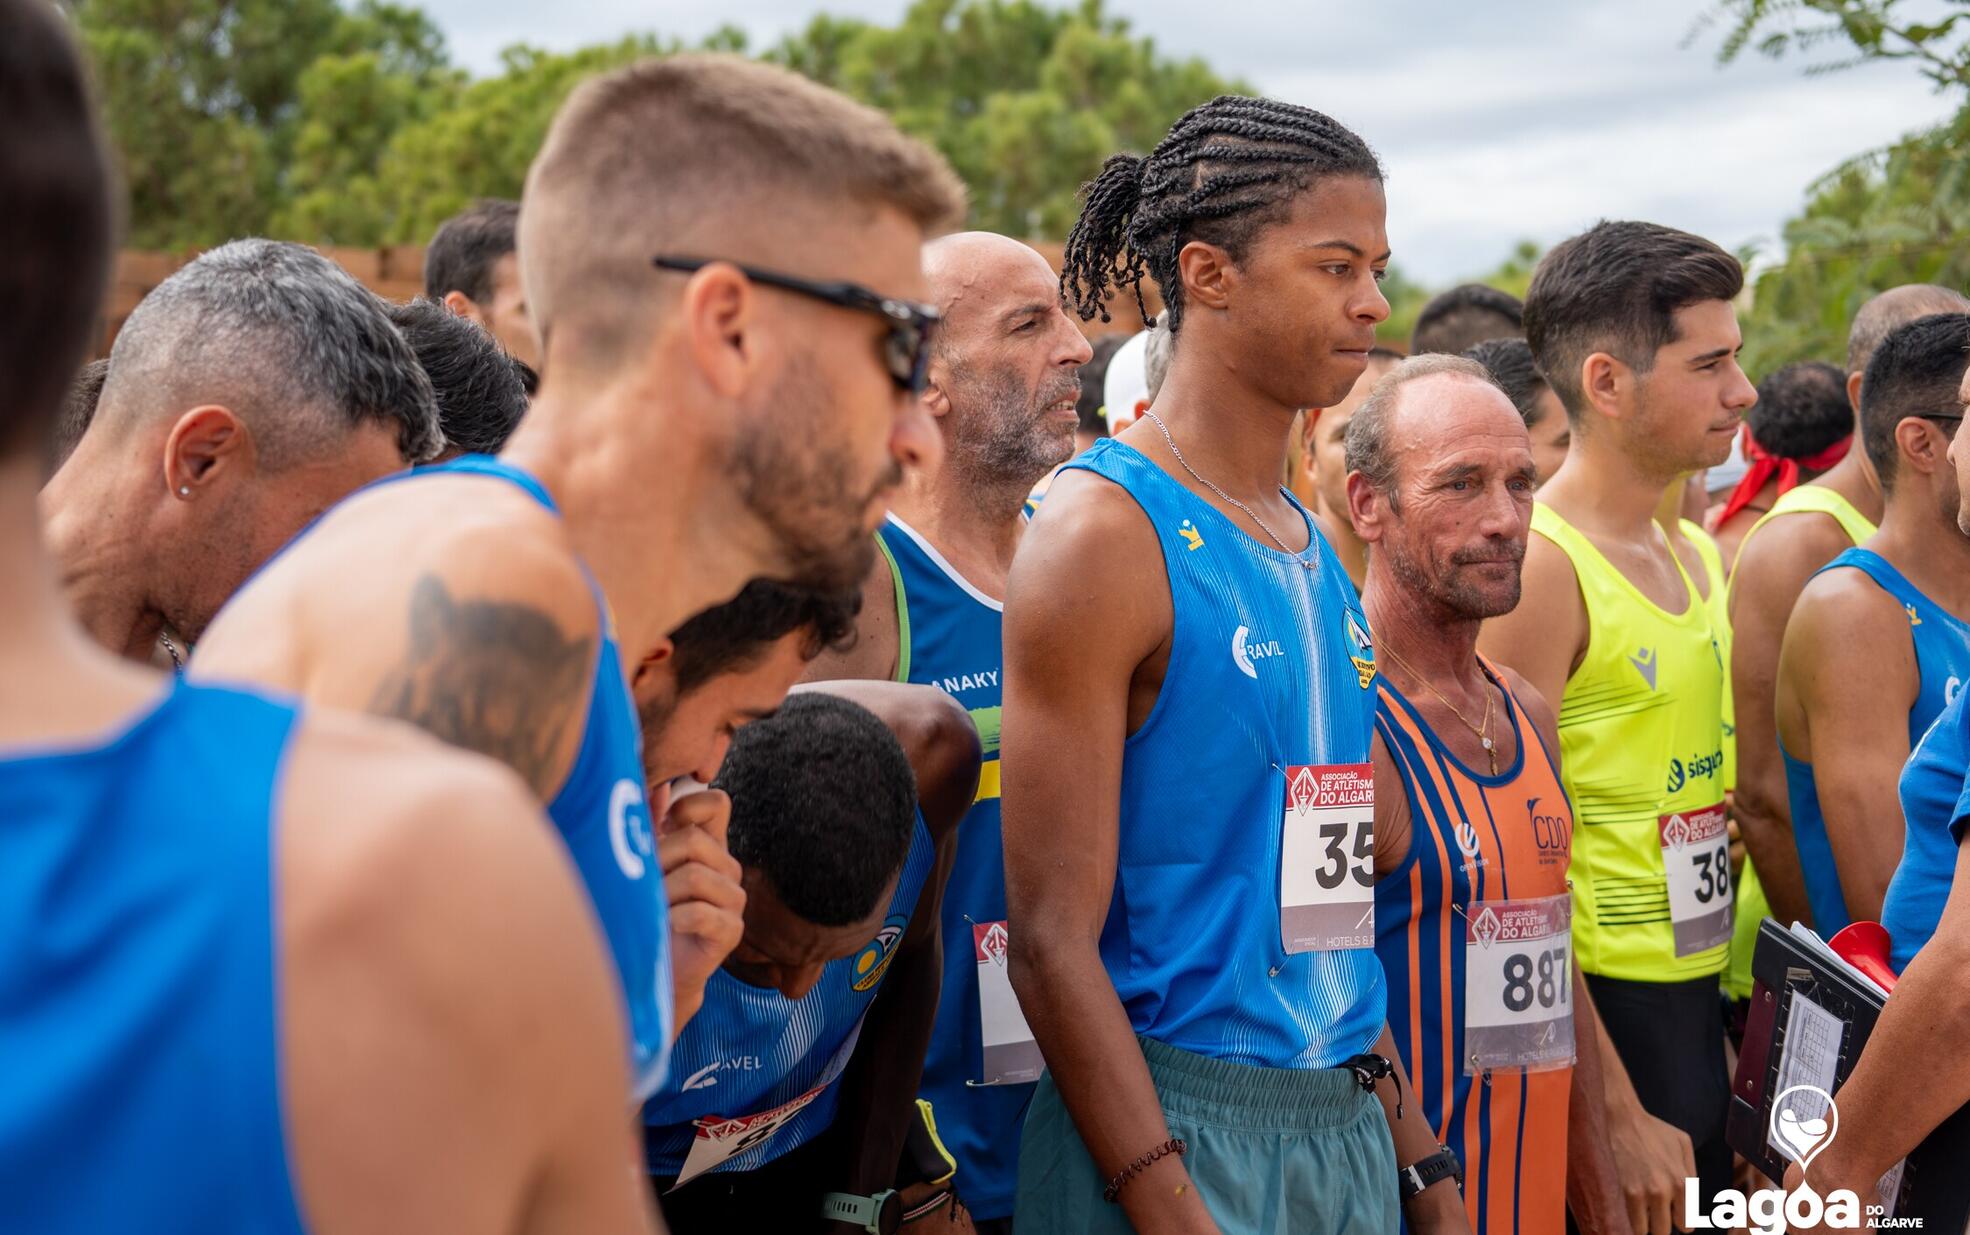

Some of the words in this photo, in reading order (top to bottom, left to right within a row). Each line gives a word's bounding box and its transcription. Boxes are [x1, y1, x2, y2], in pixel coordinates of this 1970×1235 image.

[1320, 771, 1358, 781] ASSOCIAÇÃO
[1320, 781, 1332, 792] DE
[1320, 791, 1336, 805] DO
[1692, 845, 1728, 903] 38
[1502, 918, 1514, 928] DE
[1502, 927, 1519, 939] DO
[1503, 946, 1567, 1013] 887
